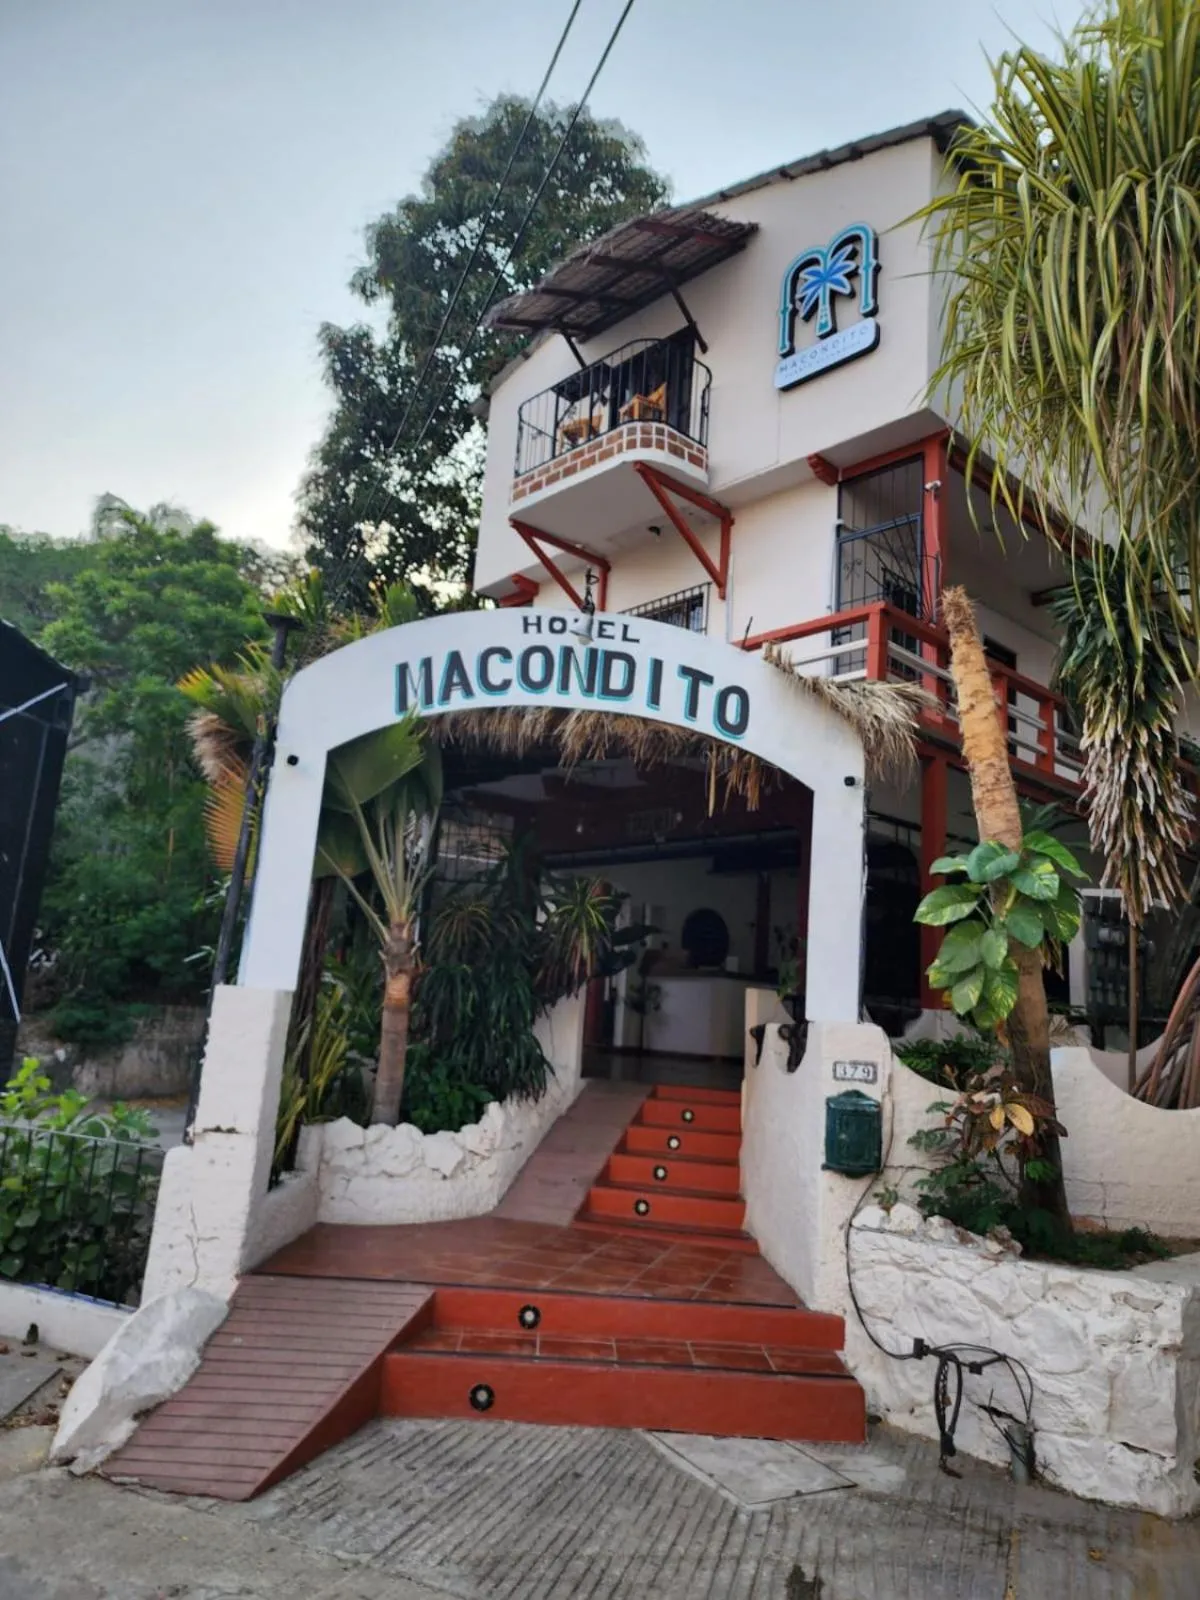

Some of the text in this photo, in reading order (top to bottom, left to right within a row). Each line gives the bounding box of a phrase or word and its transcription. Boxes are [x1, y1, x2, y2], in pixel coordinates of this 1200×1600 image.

[779, 325, 869, 373] MACONDITO
[522, 616, 640, 643] HOEL
[395, 645, 750, 739] MACONDITO
